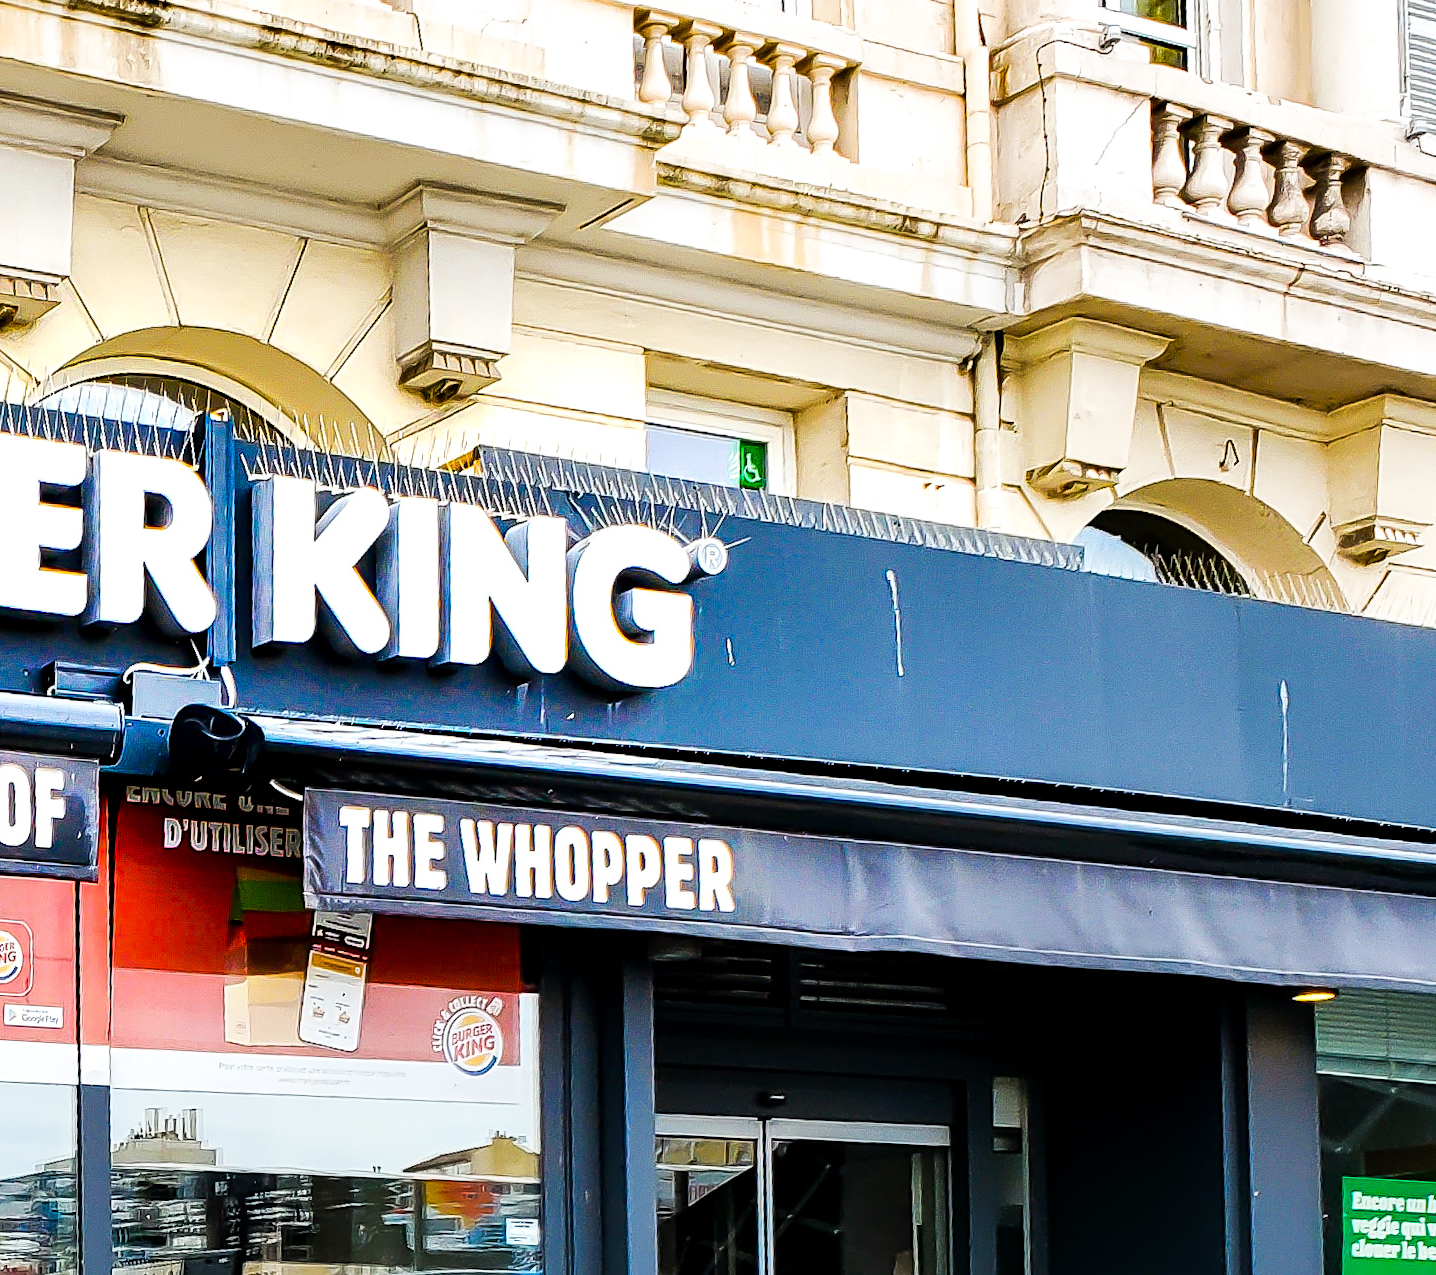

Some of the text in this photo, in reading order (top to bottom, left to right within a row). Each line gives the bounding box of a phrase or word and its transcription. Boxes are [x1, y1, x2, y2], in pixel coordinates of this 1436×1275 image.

[163, 817, 302, 859] D'UTILISER
[338, 805, 737, 913] THE WHOPPER
[431, 1018, 446, 1053] CLICK
[448, 995, 489, 1014] COLLECT
[452, 1023, 493, 1046] BURGER
[454, 1035, 496, 1062] KING
[1351, 1190, 1405, 1212] Encore
[1351, 1214, 1401, 1240] veggie
[1401, 1216, 1427, 1241] qui
[1401, 1240, 1417, 1260] le
